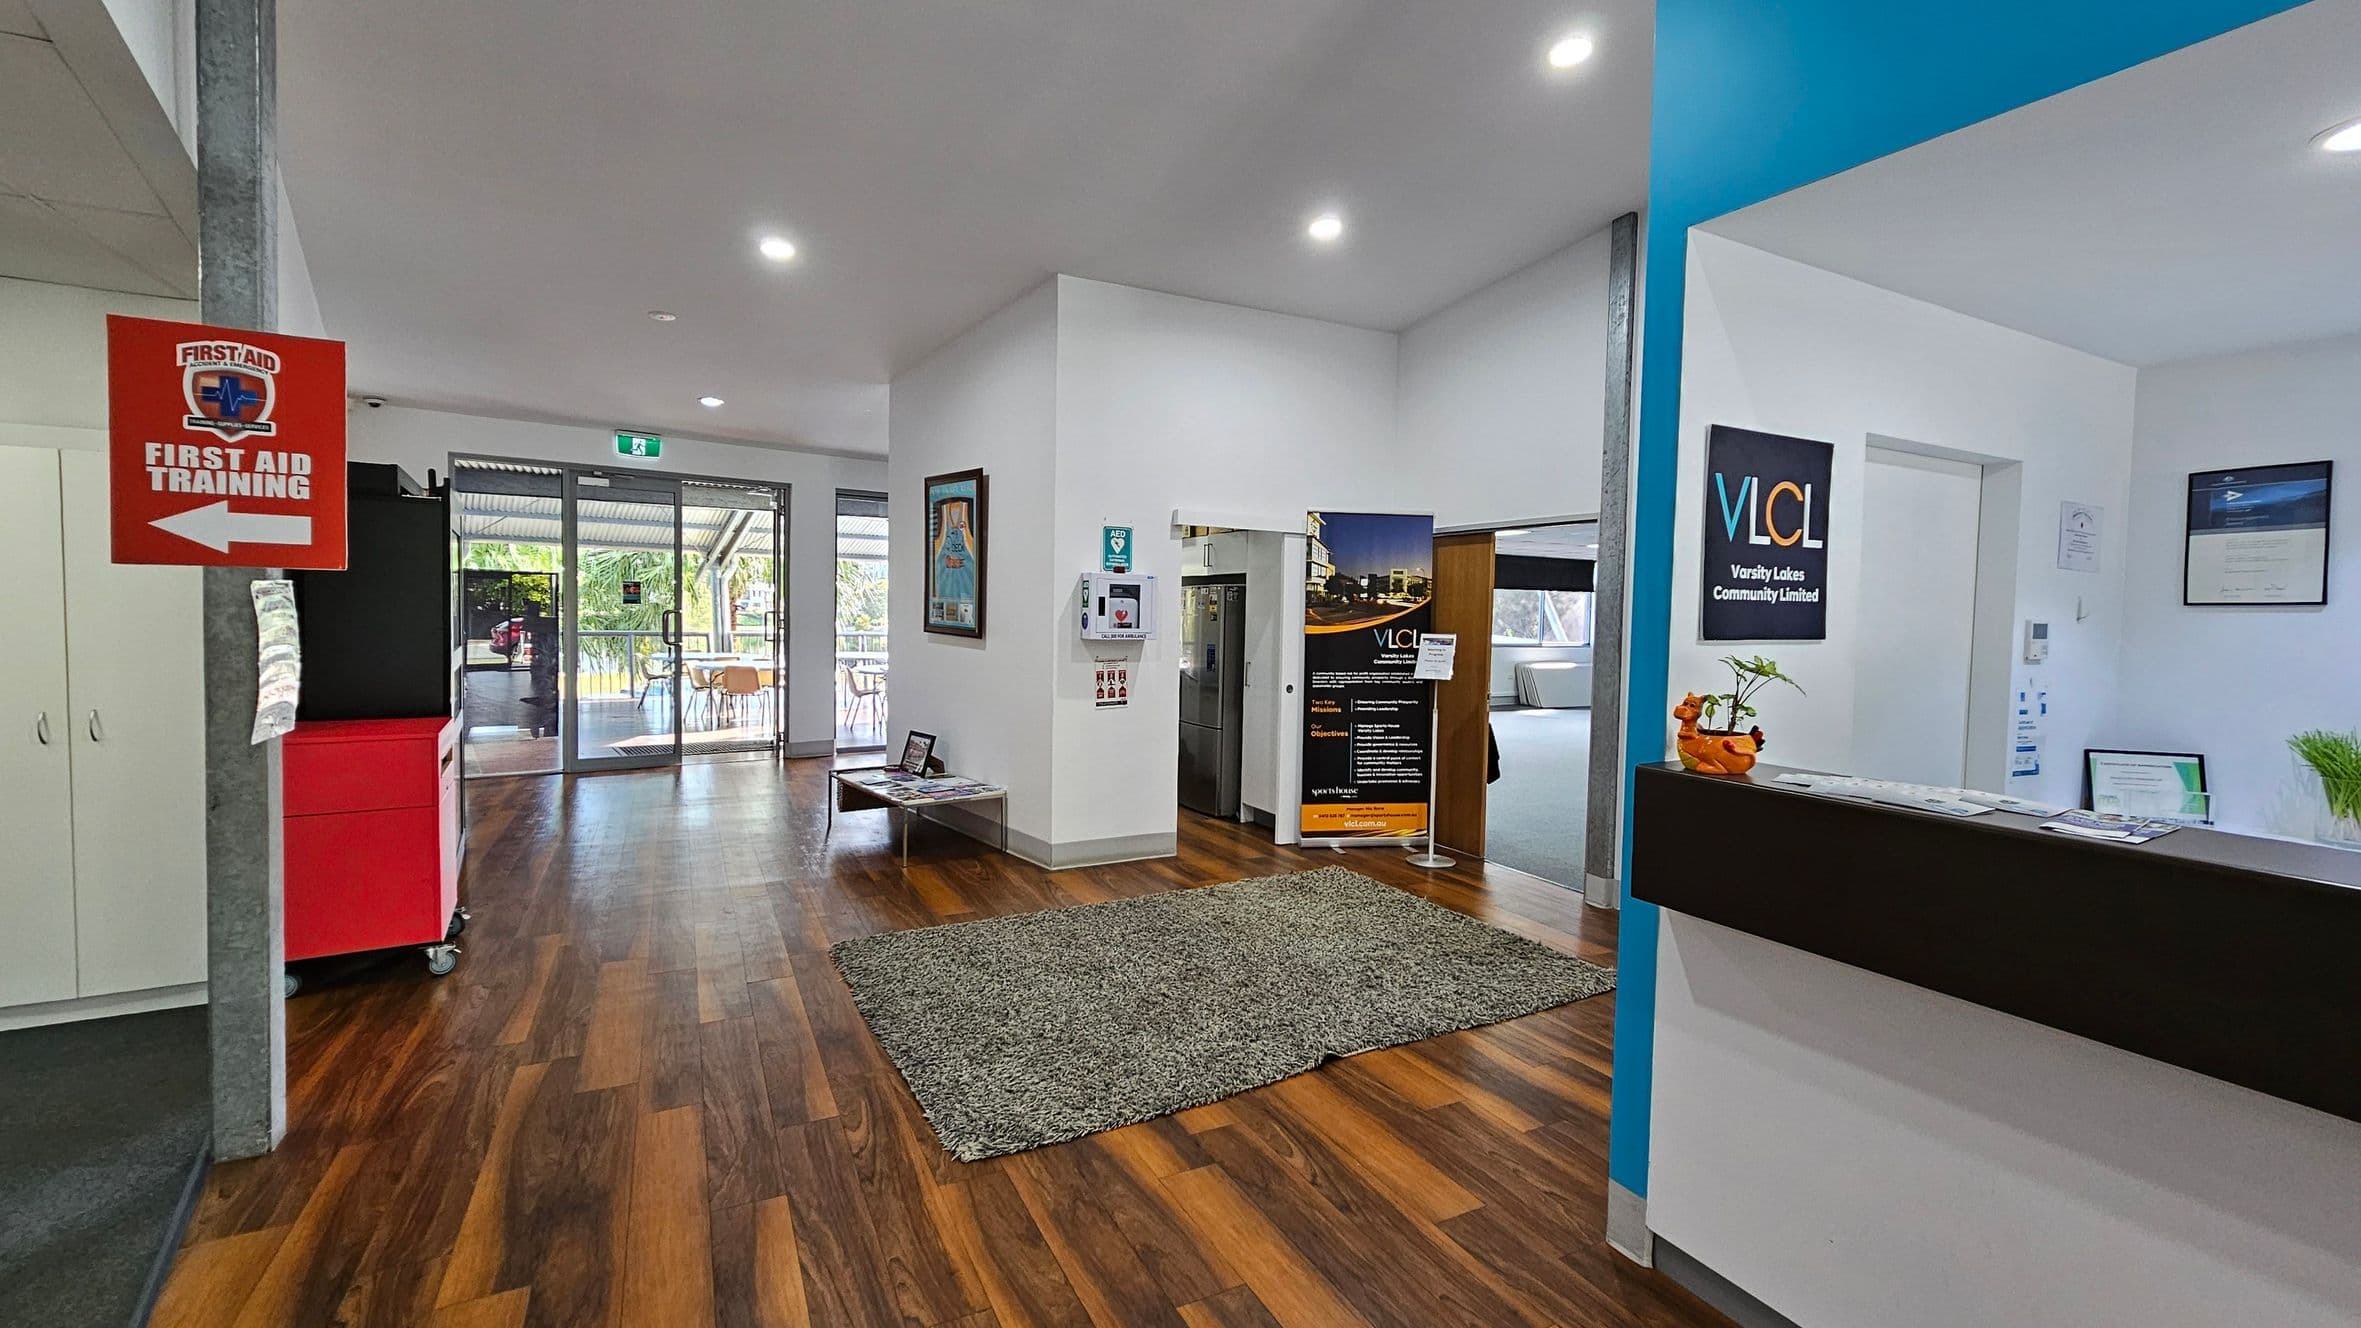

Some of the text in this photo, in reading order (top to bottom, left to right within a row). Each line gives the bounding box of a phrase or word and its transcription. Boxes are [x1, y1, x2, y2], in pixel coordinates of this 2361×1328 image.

[182, 344, 276, 371] FIRST AID
[145, 442, 312, 475] FIRST AID
[146, 466, 311, 500] TRAINING
[1715, 473, 1823, 549] VLCL
[1110, 529, 1126, 538] AED
[1731, 564, 1805, 583] Varsity Lakes
[1713, 585, 1819, 604] Community Limited
[1373, 628, 1421, 649] VLCL
[1310, 730, 1348, 738] Objectives
[1311, 786, 1358, 797] sportshouse
